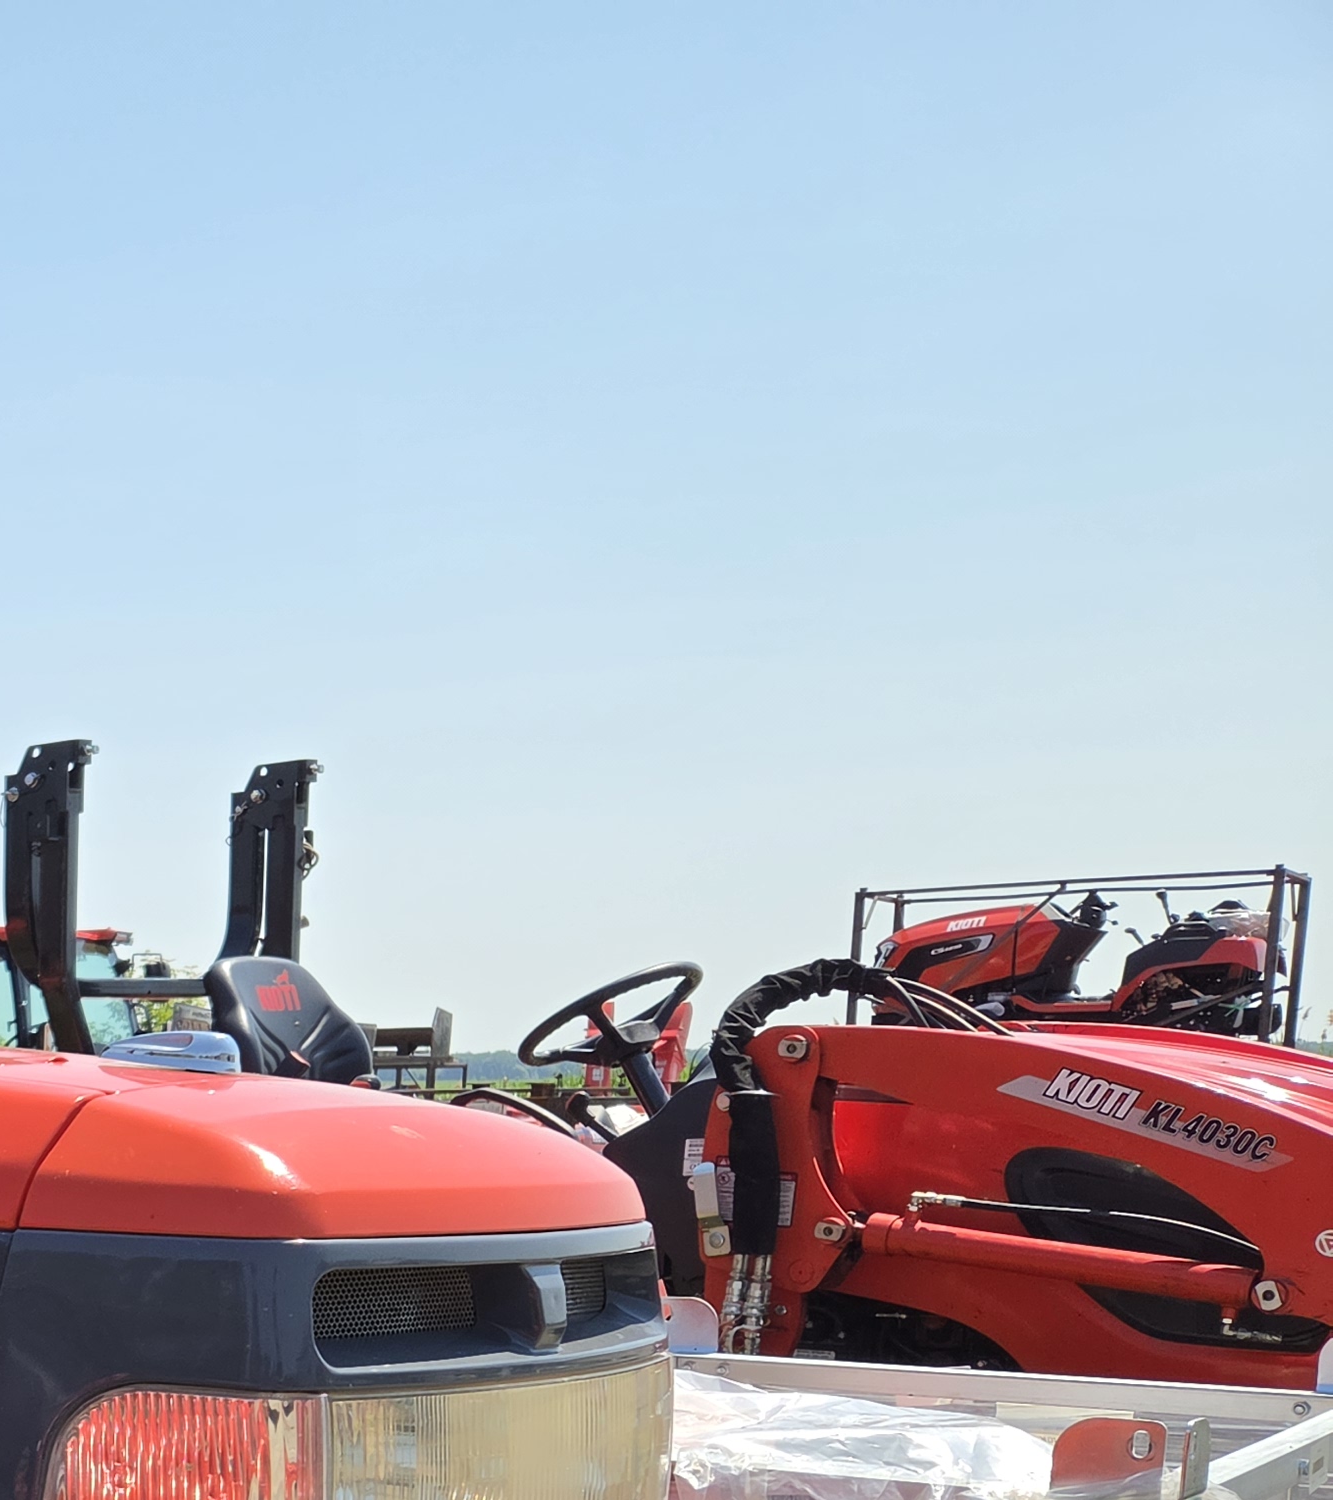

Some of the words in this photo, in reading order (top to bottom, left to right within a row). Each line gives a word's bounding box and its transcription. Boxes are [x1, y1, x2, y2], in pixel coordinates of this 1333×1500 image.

[946, 916, 988, 932] KIOTI
[1043, 1067, 1143, 1120] KIOTI
[1139, 1099, 1278, 1163] KL4030C
